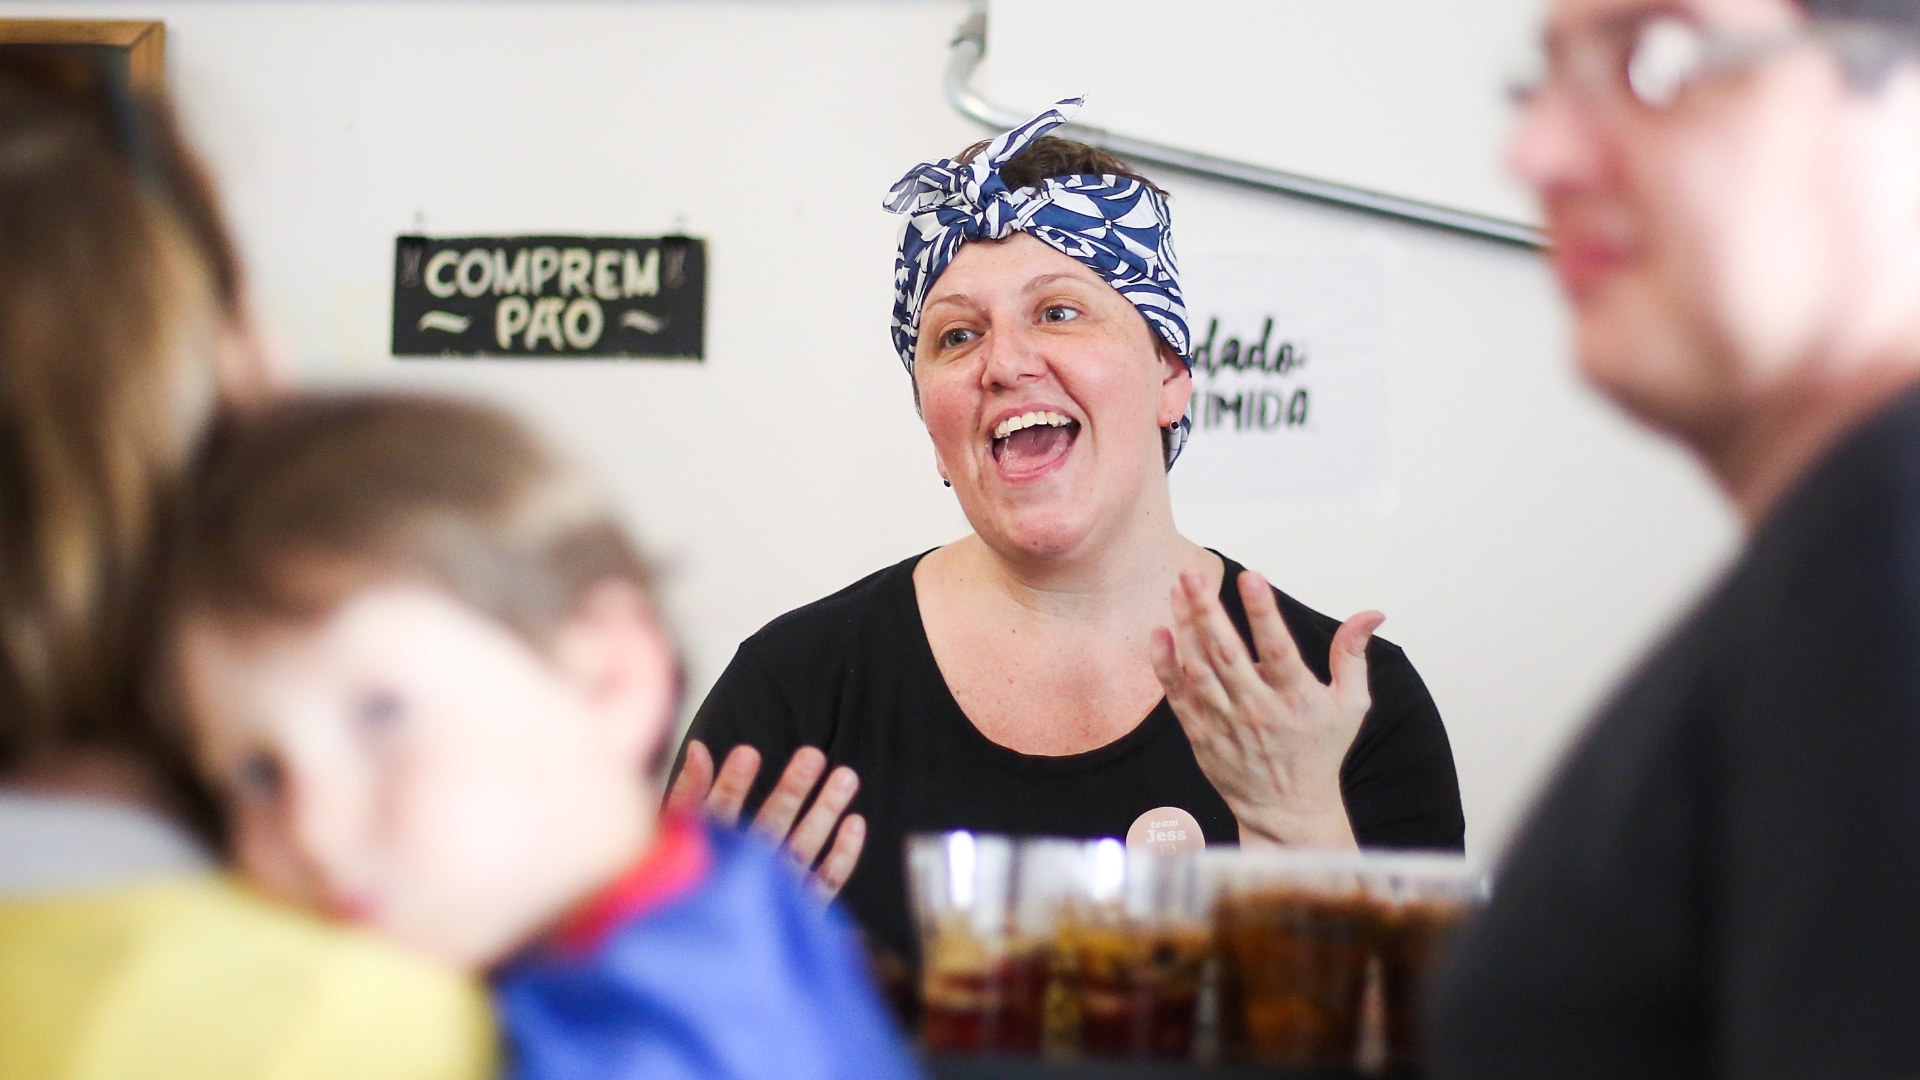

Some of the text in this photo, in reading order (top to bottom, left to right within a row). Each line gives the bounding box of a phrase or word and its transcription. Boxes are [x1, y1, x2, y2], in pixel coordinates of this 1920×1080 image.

[424, 247, 660, 299] COMPREM
[496, 297, 604, 351] PÃO
[1146, 830, 1187, 843] Jess
[1150, 820, 1179, 829] team
